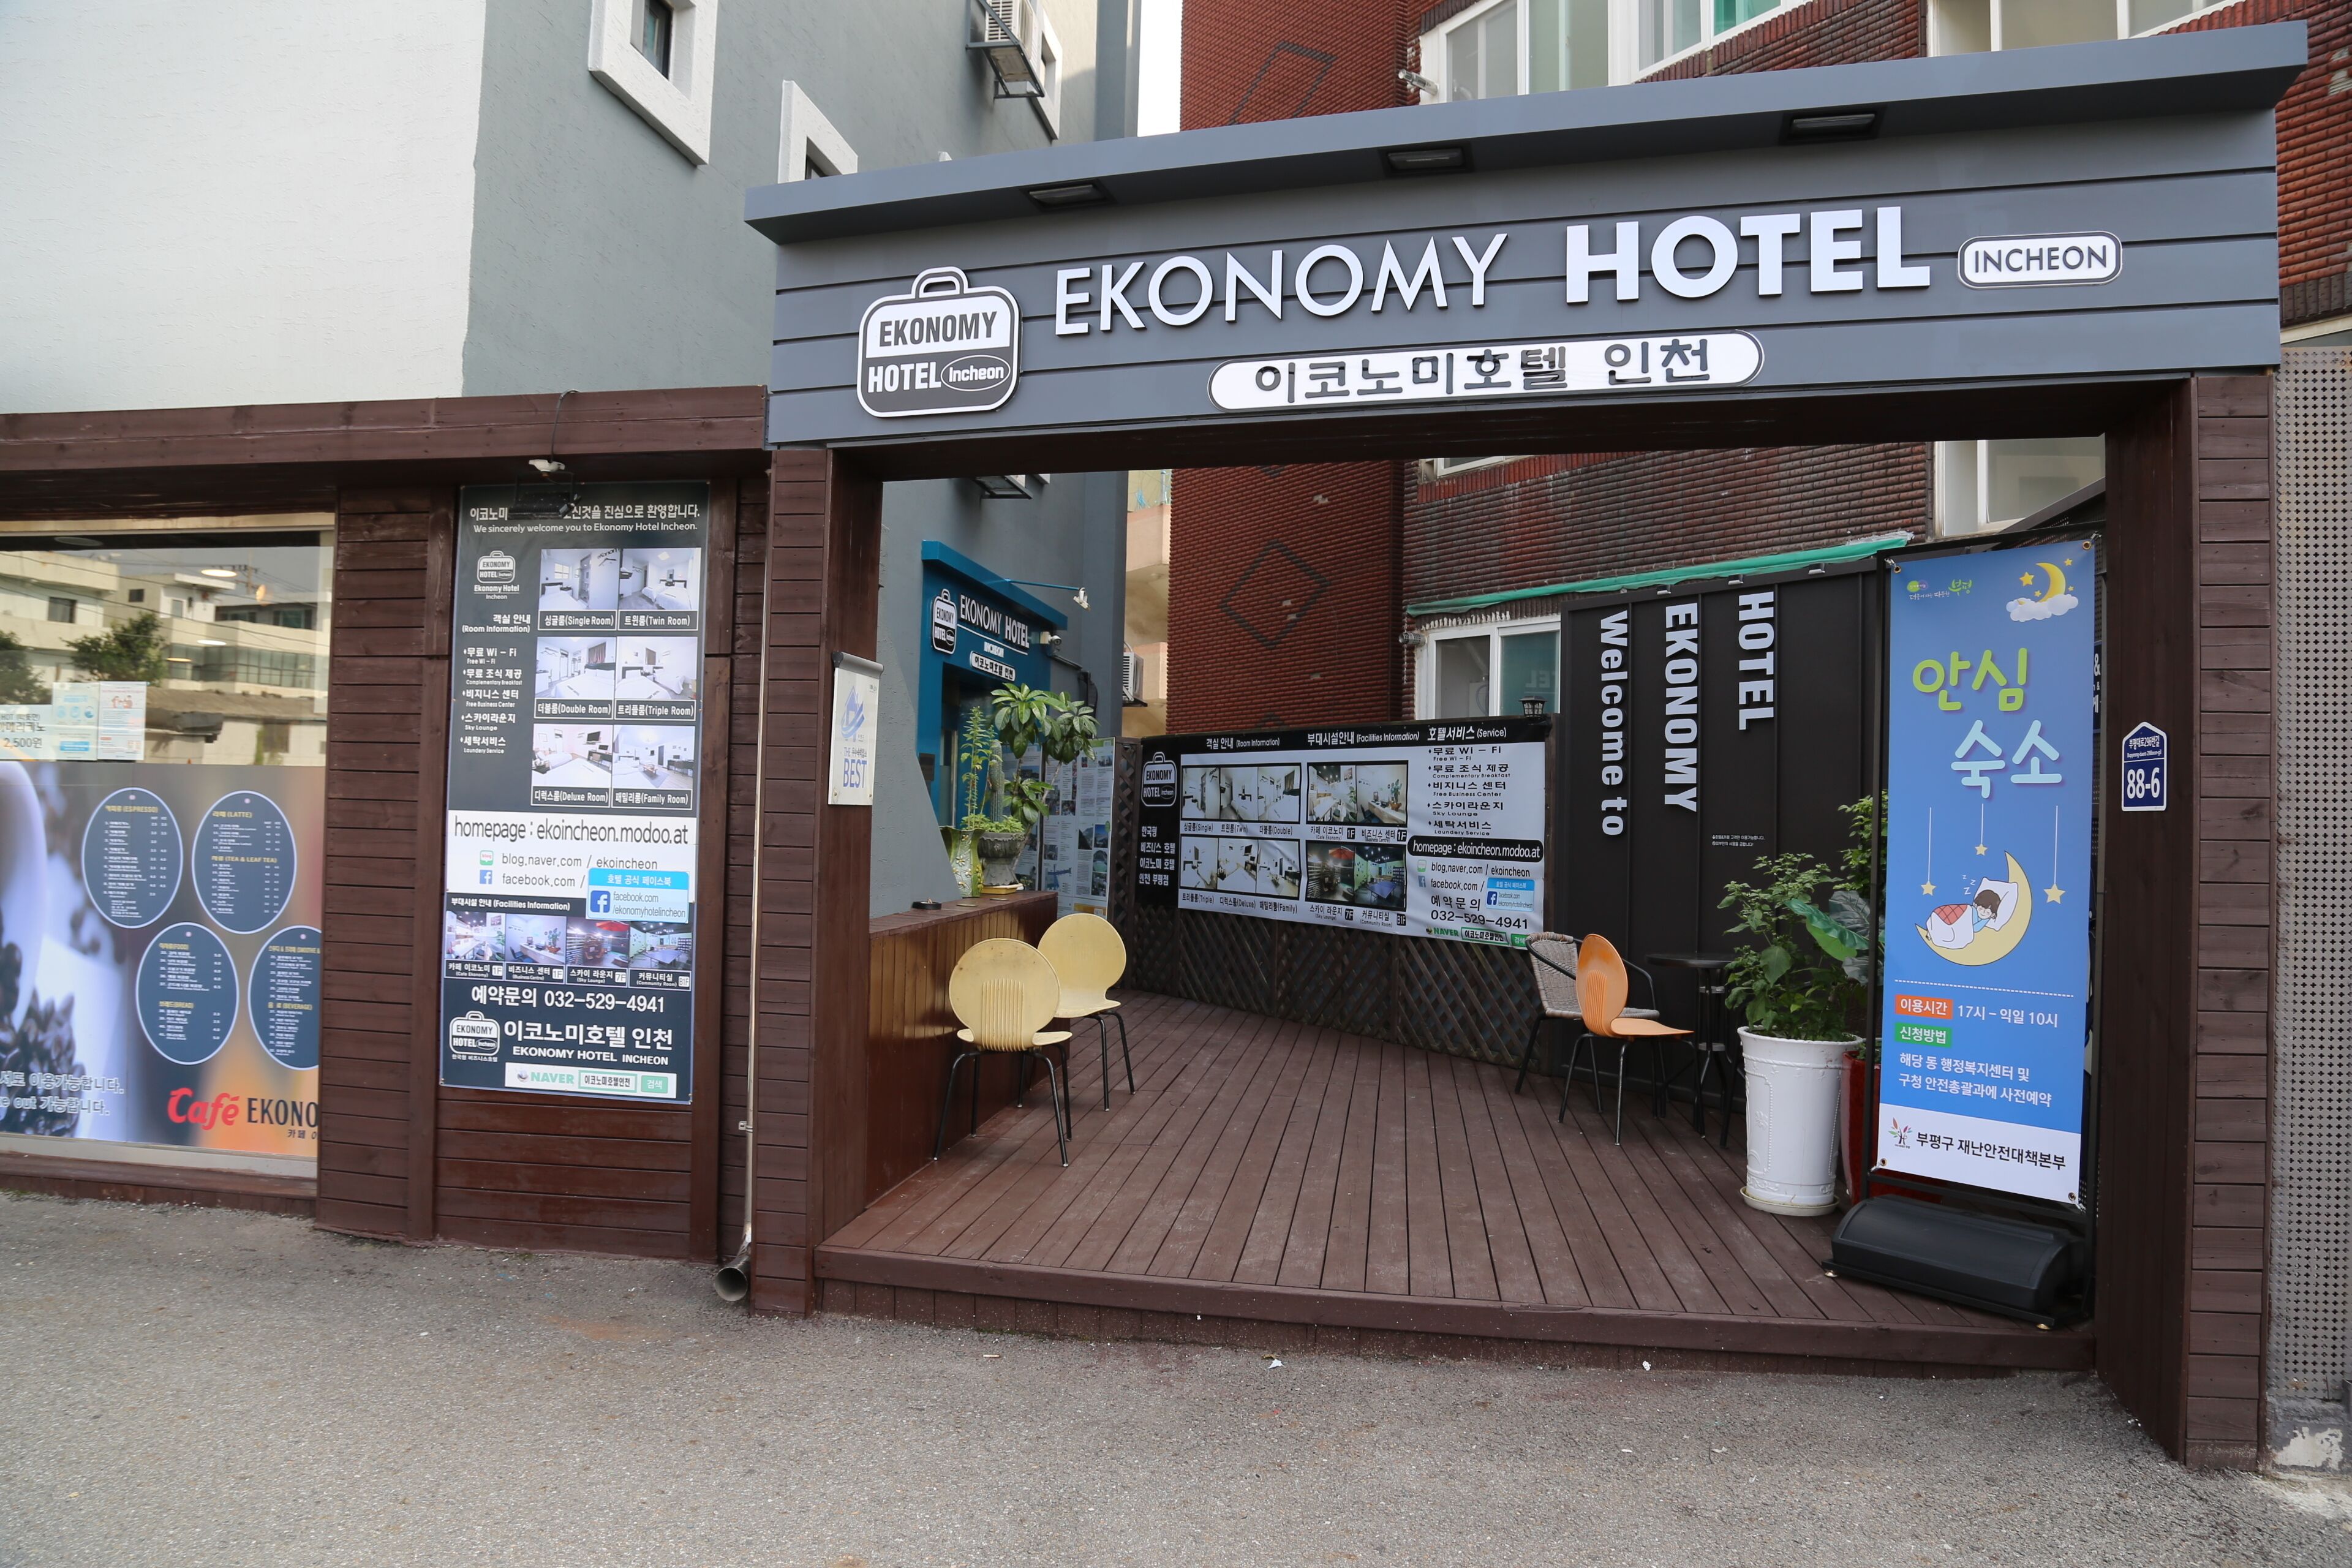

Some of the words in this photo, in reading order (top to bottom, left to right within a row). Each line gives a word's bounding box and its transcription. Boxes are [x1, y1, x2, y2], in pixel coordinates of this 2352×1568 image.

[1974, 245, 2108, 273] INCHEON
[1055, 233, 1508, 336] EKONOMY
[1566, 206, 1931, 303] HOTEL
[880, 311, 997, 347] EKONOMY
[867, 361, 941, 393] HOTEL
[949, 365, 1004, 382] Incheon
[1255, 345, 1569, 403] 이코노미호텔
[1604, 339, 1709, 384] 인천
[605, 505, 644, 519] 진심으로
[647, 504, 699, 519] 환영합니다.
[488, 524, 525, 533] sincerely
[594, 523, 633, 532] Ekonomy
[493, 614, 510, 624] 객실
[513, 614, 530, 624] 안내
[937, 607, 954, 624] EKONOMY
[960, 595, 1002, 634] EKONOMY
[1005, 616, 1029, 648] HOTEL
[935, 626, 946, 641] HOTEL
[984, 642, 1004, 657] INCHEON
[975, 656, 1003, 676] 이코노미호텔
[1005, 665, 1012, 680] 인천
[1738, 591, 1774, 730] HOTEL
[467, 669, 483, 678] 무료
[486, 669, 502, 678] 조식
[505, 669, 522, 679] 제공
[1912, 647, 2028, 712] 안심
[466, 689, 499, 699] 비지니스
[502, 690, 518, 699] 센터
[1600, 610, 1628, 785] Welcome
[1665, 603, 1698, 812] EKONOMY
[465, 714, 515, 723] 스카이라운지
[464, 736, 506, 746] 세탁서비스
[1308, 732, 1354, 746] 부대시설안내
[1357, 734, 1382, 743] (Facilities
[1384, 731, 1420, 741] Information)
[1428, 726, 1475, 741] 호텔서비스
[1477, 728, 1506, 737] (Service)
[4, 737, 42, 748] 2,500원
[1951, 720, 2063, 799] 숙소
[843, 758, 867, 788] BEST
[1146, 770, 1172, 781] EKONOMY
[2127, 767, 2160, 799] 88-6
[668, 794, 688, 804] Room)
[1601, 796, 1628, 835] to
[455, 815, 526, 842] homepage
[537, 818, 688, 844] ekoincheon.modoo.at
[1142, 826, 1157, 837] 한국형
[1323, 827, 1343, 835] 이코노미
[1434, 821, 1491, 829] 세탁서비스
[1362, 829, 1382, 838] 비즈니스
[1385, 830, 1395, 839] 센터
[1140, 842, 1161, 853] 비즈니스
[1164, 843, 1175, 854] 호텔
[1413, 840, 1452, 855] homepage
[1458, 842, 1540, 858] ekoincheon.modoo.at
[502, 853, 581, 867] blog.naver.com
[597, 857, 657, 870] ekoincheon
[1140, 859, 1161, 869] 이코노미
[1164, 860, 1174, 870] 호텔
[1431, 862, 1482, 874] blog.naver.com
[1491, 867, 1530, 877] ekoincheon
[502, 873, 575, 887] facebook.com
[1431, 879, 1477, 891] facebook.com
[613, 891, 658, 902] facebook.com
[612, 907, 685, 918] /ekonomyhotelincheon
[1431, 910, 1528, 929] 032-529-4941
[1434, 928, 1459, 937] NAVER
[472, 985, 537, 1008] 예약문의
[545, 989, 664, 1012] 032-529-4941
[1900, 998, 1947, 1016] 이용시간
[1958, 1005, 1986, 1020] 17시
[1999, 1008, 2024, 1024] 익일
[2029, 1011, 2058, 1028] 10시
[456, 1024, 493, 1035] EKONOMY
[504, 1020, 625, 1049] 이코노미호텔
[632, 1028, 672, 1050] 인천
[1900, 1027, 1947, 1044] 신청방법
[513, 1046, 575, 1059] EKONOMY
[578, 1050, 617, 1061] HOTEL
[622, 1055, 668, 1065] INCHEON
[1899, 1052, 1923, 1069] 해당
[1926, 1055, 1937, 1071] 동
[1941, 1058, 2013, 1080] 행정복지센터
[2018, 1068, 2029, 1082] 및
[29, 1072, 124, 1094] 이용가능합니다.
[530, 1072, 574, 1084] NAVER
[584, 1076, 630, 1087] 이코노미호텔인천
[647, 1080, 662, 1089] 검색
[1899, 1074, 1921, 1089] 구청
[1925, 1077, 1997, 1099] 안전총괄과에
[2000, 1090, 2052, 1107] 사전예약
[40, 1096, 110, 1115] 가능합니다.
[167, 1087, 239, 1130] Café
[288, 1129, 305, 1139] 카페
[1917, 1132, 1954, 1151] 부평구
[1958, 1138, 2066, 1170] 재난안전대책본부
